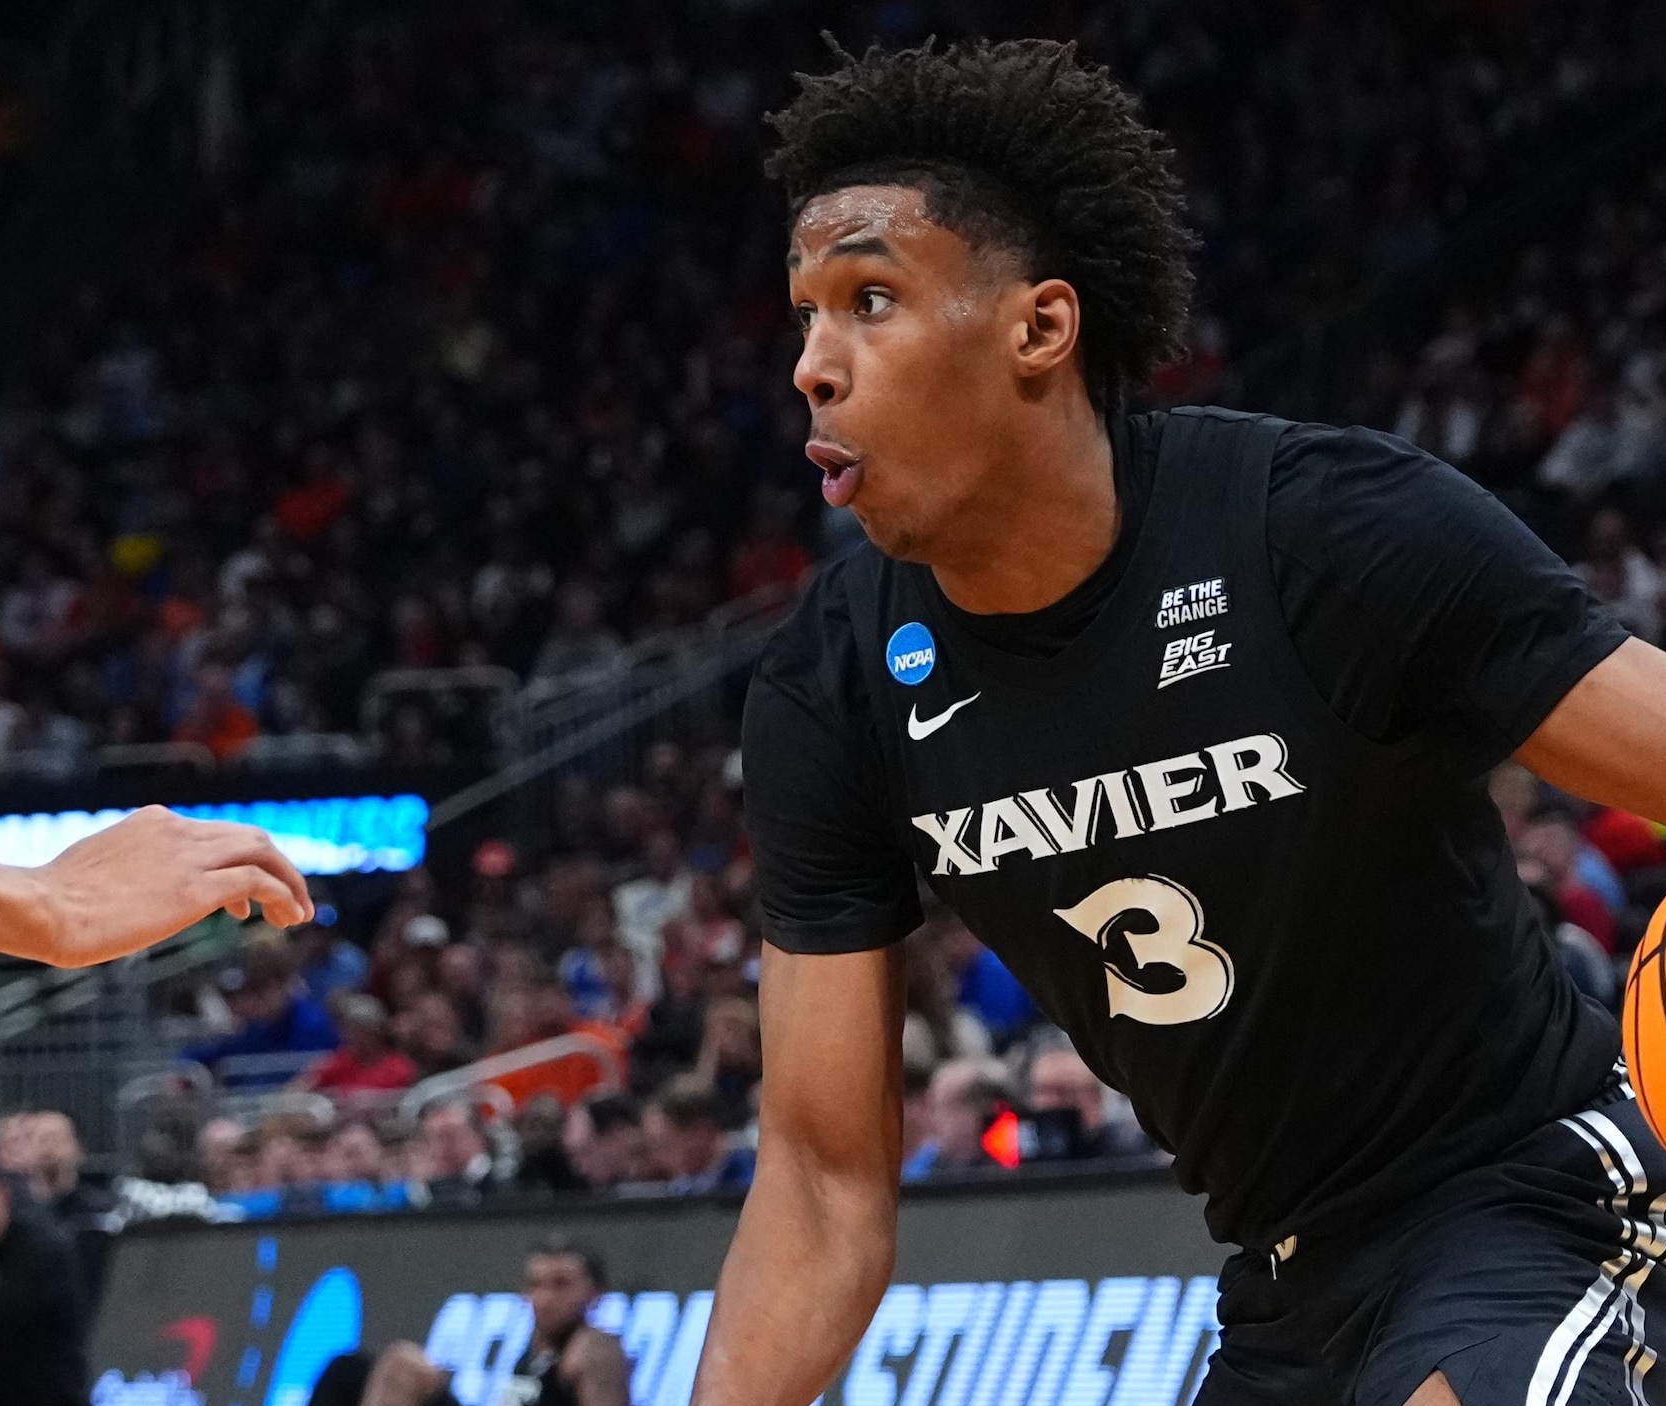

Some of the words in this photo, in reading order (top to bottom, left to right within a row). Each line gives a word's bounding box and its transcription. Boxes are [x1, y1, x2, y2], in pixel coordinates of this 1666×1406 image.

[1161, 588, 1185, 610] BE
[1189, 579, 1222, 602] THE
[1156, 595, 1228, 629] CHANGE
[894, 647, 933, 673] NCAA
[1159, 643, 1232, 679] EAST
[1163, 629, 1215, 661] BIG
[912, 732, 1307, 876] XAVIER
[1053, 873, 1235, 1026] 3
